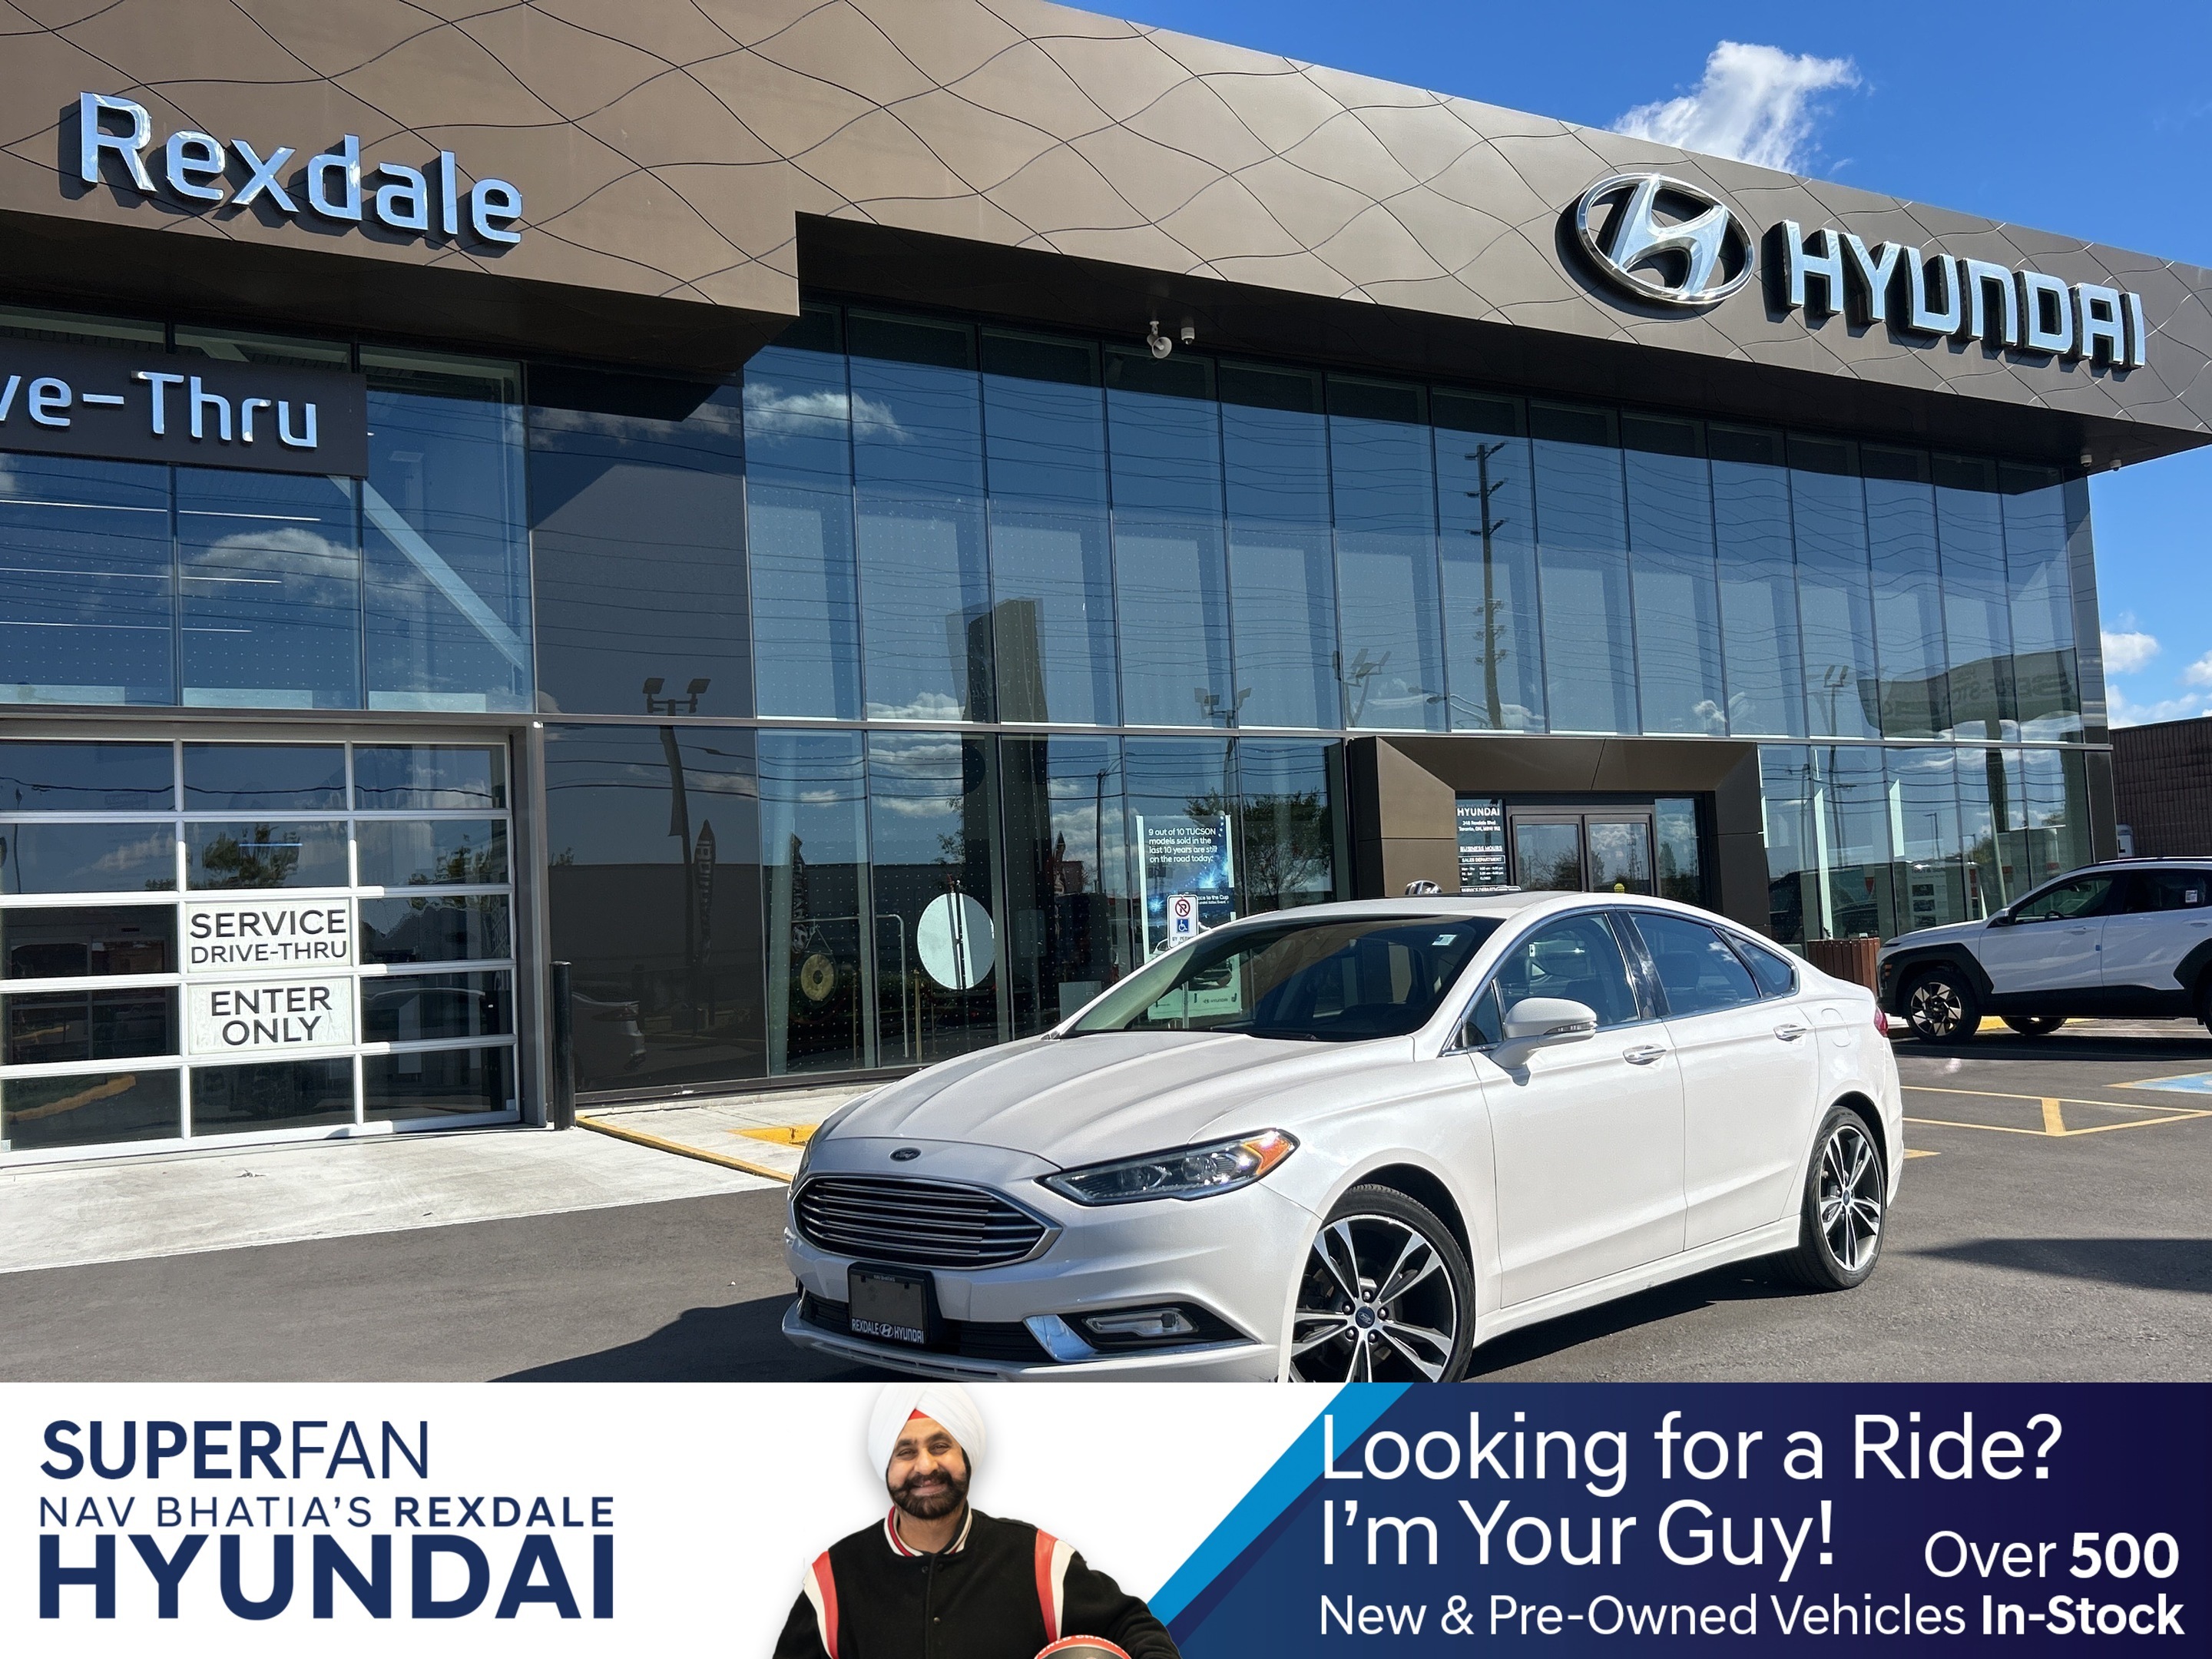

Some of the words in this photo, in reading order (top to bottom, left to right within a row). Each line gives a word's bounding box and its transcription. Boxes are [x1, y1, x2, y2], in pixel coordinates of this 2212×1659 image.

[79, 91, 523, 245] Rexdale
[1781, 218, 2145, 369] HYUNDAI
[1456, 807, 1500, 816] HYUNDAI
[1149, 836, 1175, 845] models
[1185, 827, 1216, 836] TUCSON
[1149, 846, 1163, 854] last
[1173, 846, 1192, 855] years
[1206, 845, 1217, 853] still
[189, 909, 346, 939] SERVICE
[191, 940, 347, 964] DRIVE-THRU
[211, 985, 333, 1017] ENTER
[222, 1015, 322, 1046] ONLY
[851, 1318, 879, 1336] REXDALE
[893, 1325, 924, 1344] HYUNDAI
